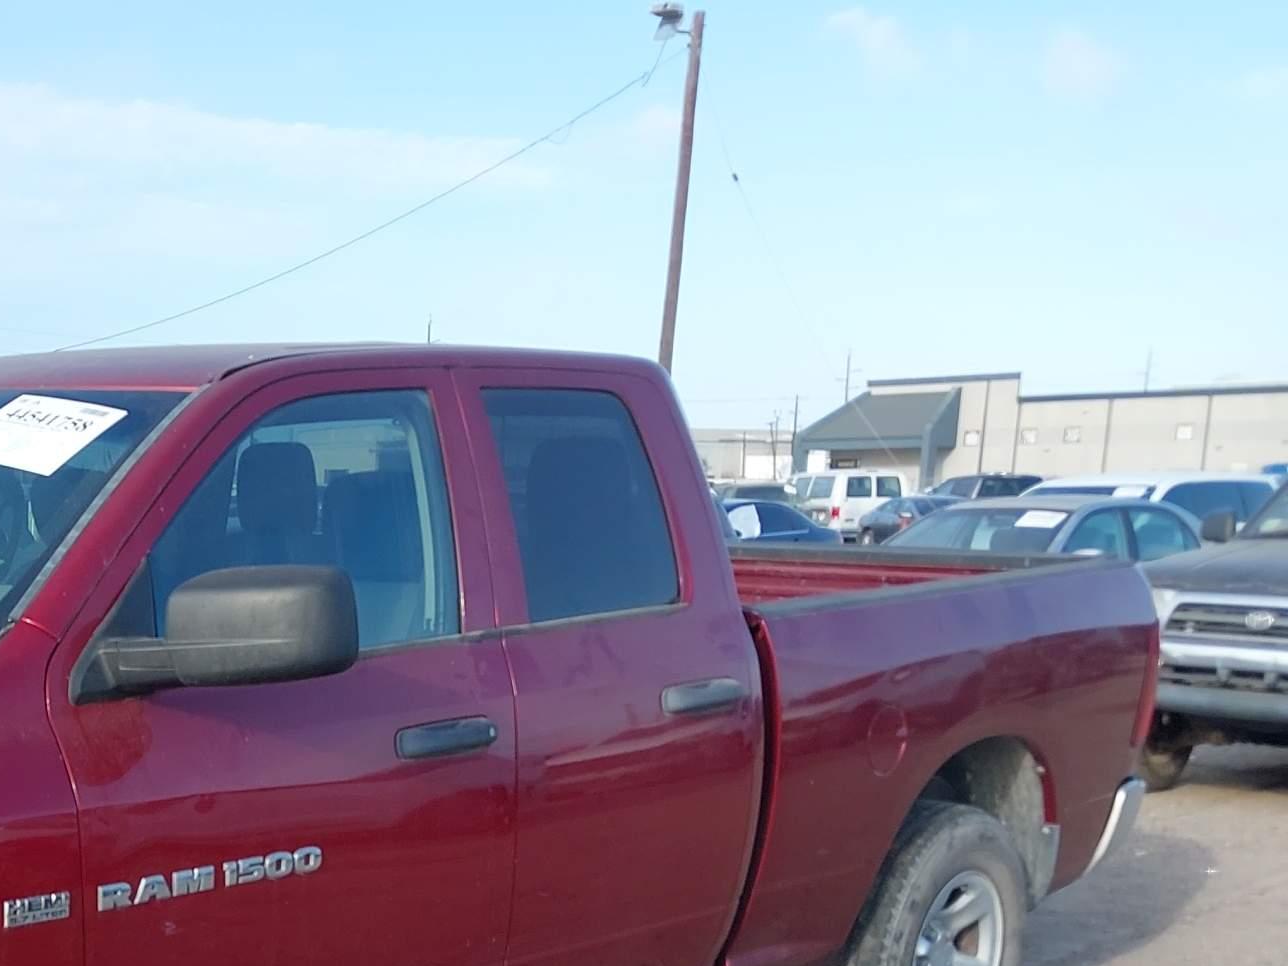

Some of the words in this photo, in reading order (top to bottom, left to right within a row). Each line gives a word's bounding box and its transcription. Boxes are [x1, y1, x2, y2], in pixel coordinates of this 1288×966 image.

[6, 408, 94, 432] 44541758
[97, 865, 215, 912] RAM
[222, 845, 322, 888] 1500
